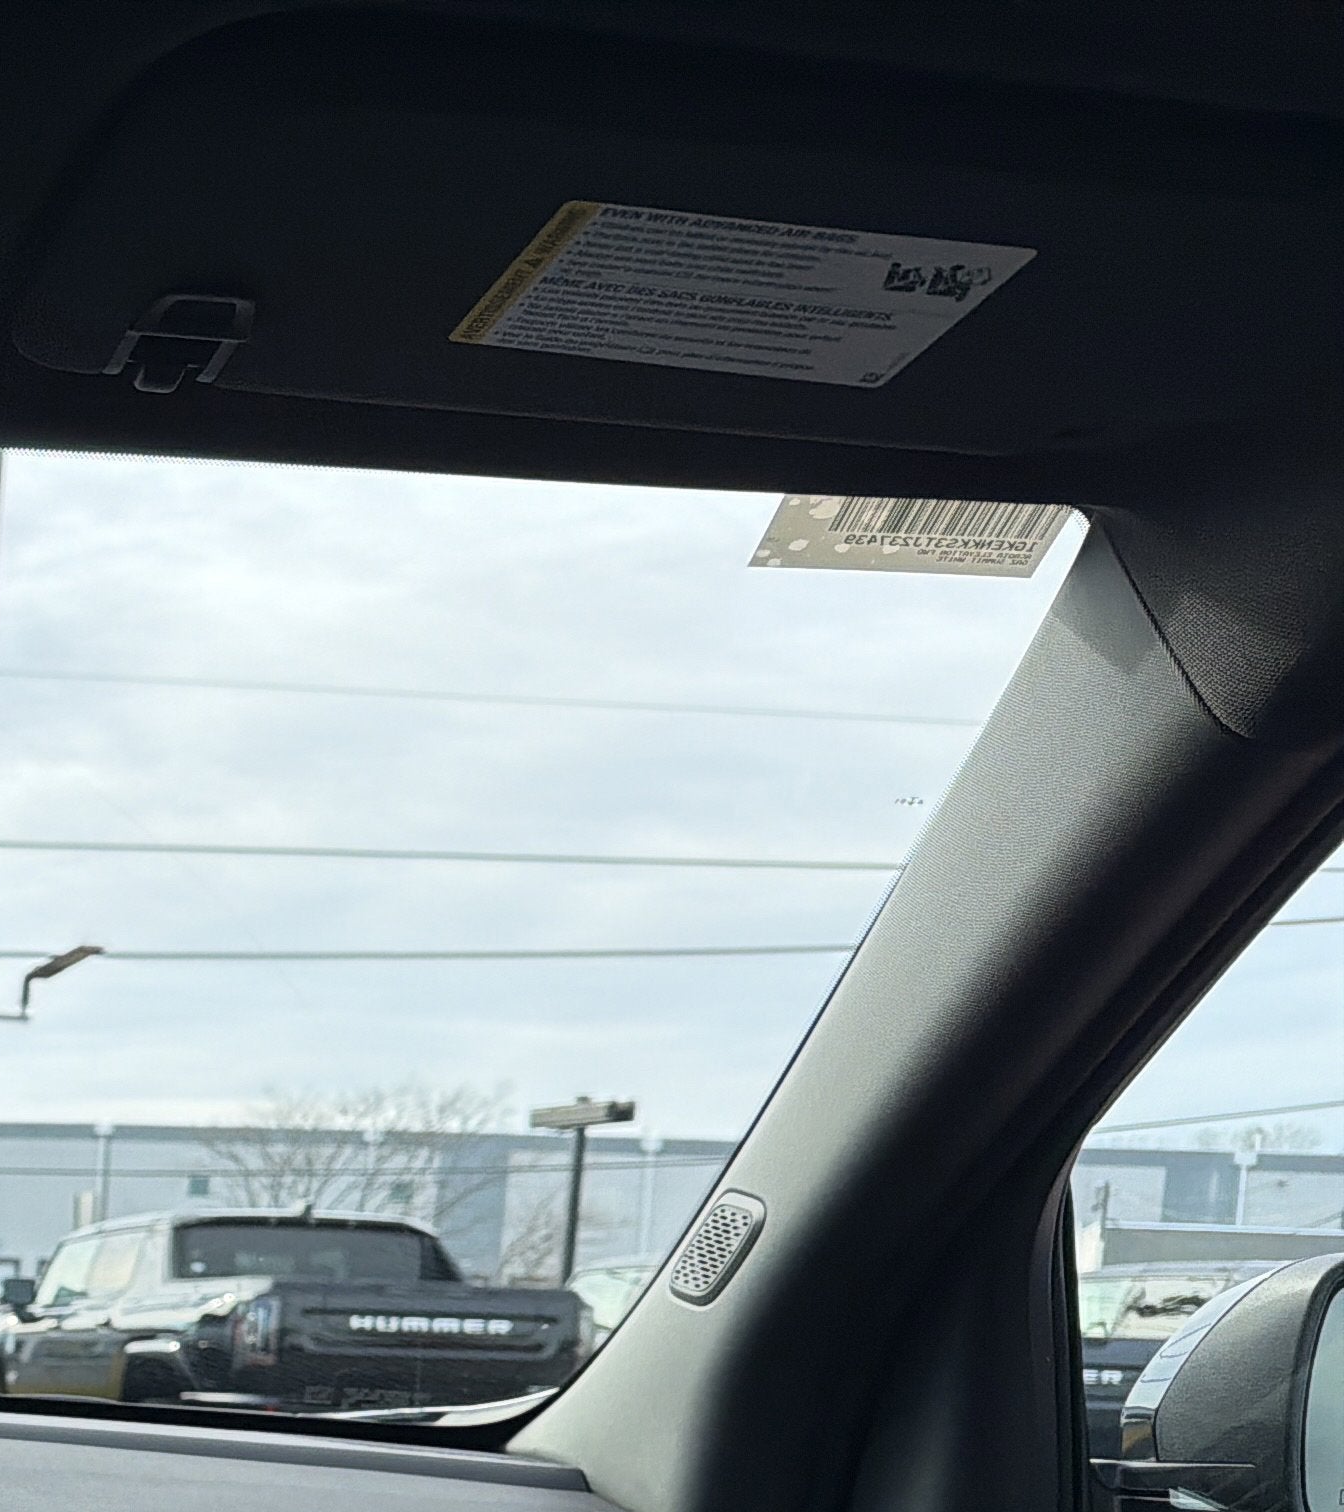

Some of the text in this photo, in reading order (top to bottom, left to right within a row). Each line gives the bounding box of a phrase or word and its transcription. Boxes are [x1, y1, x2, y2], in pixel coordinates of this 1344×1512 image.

[600, 207, 860, 243] EVEN WITH ADVANCED AIR BAGS
[349, 1314, 514, 1336] HUMMER
